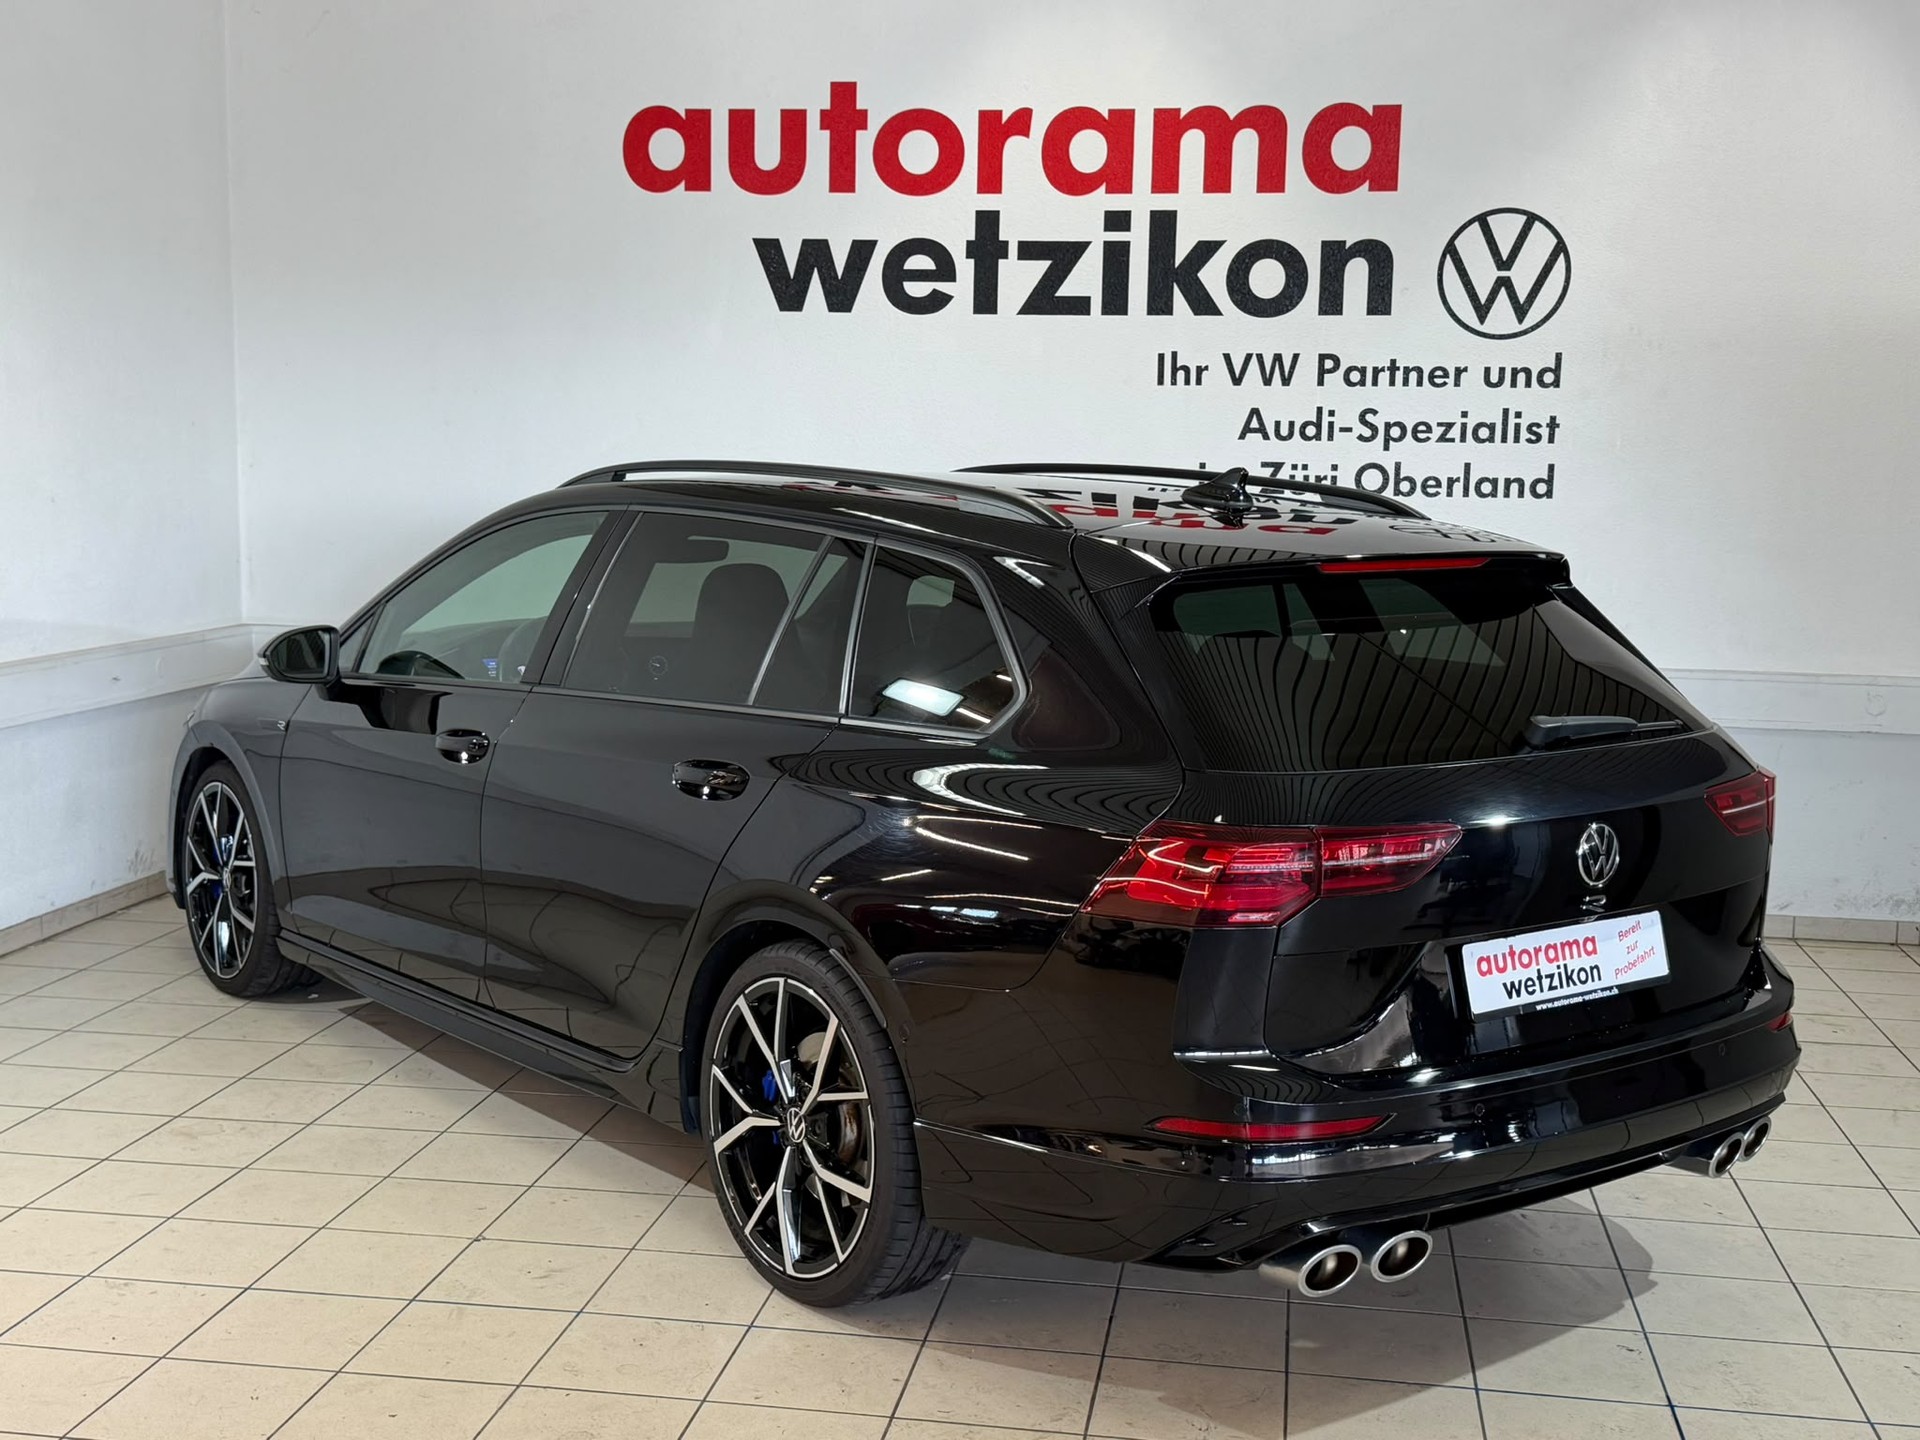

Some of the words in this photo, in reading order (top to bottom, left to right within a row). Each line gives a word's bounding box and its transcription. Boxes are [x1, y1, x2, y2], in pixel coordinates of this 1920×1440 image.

[623, 82, 1401, 196] autorama
[752, 210, 1394, 318] wetzikon
[1157, 351, 1209, 386] Ihr
[1222, 352, 1301, 387] VW
[1316, 353, 1469, 389] Partner
[1483, 352, 1563, 389] und
[1237, 406, 1561, 452] Audi-Spezialist
[1354, 461, 1555, 500] Oberland
[1617, 920, 1642, 943] Bereit
[1625, 940, 1640, 955] zur
[1476, 936, 1599, 978] autorama
[1614, 945, 1657, 980] Probefahrt
[1502, 963, 1603, 1000] wetzikon
